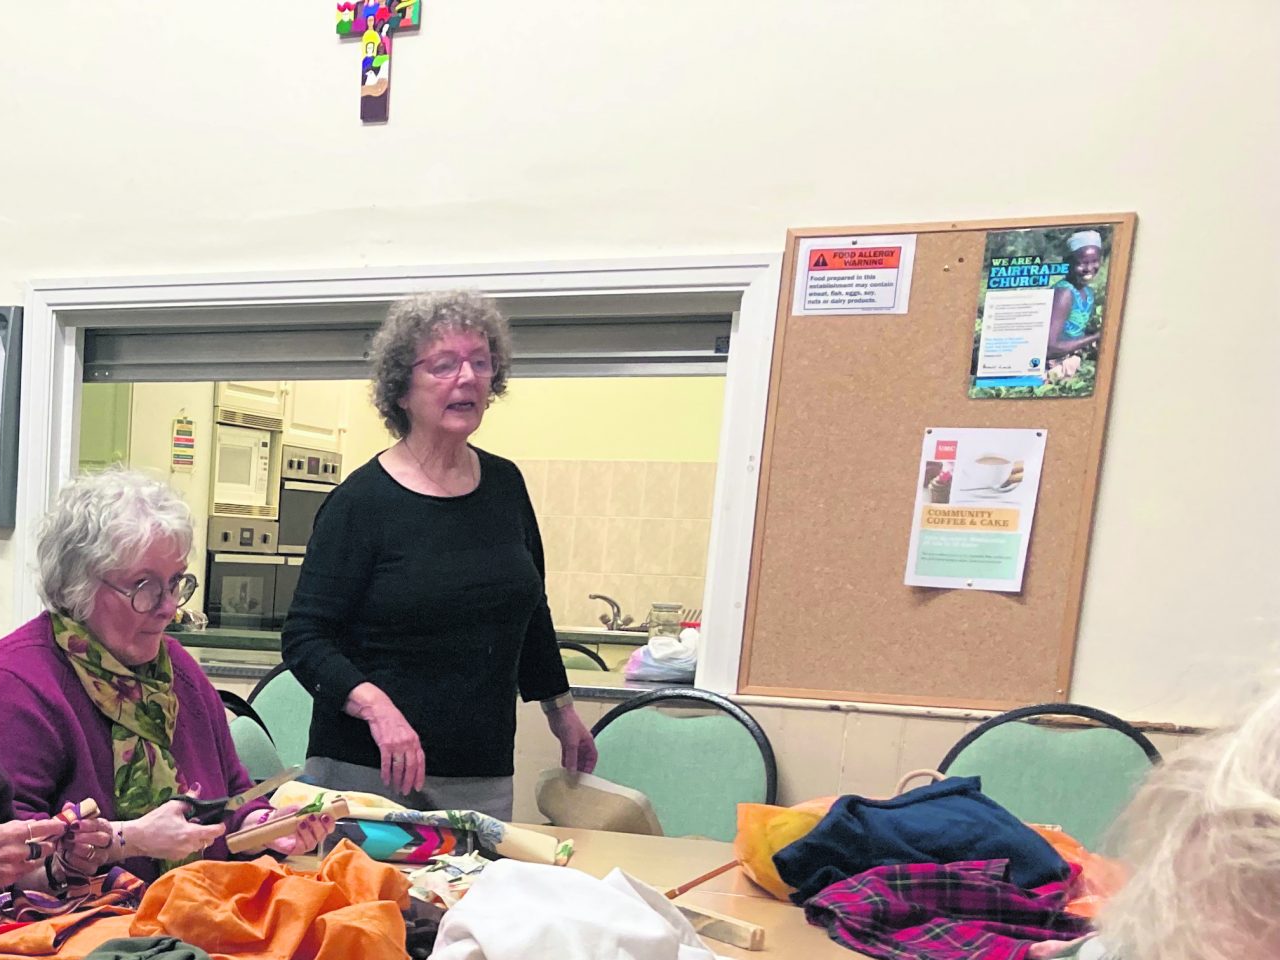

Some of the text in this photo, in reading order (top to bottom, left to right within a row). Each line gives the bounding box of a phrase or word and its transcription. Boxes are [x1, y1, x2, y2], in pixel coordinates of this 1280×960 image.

[833, 250, 896, 259] FOOD ALLERGY
[843, 258, 884, 267] WARNING
[992, 256, 1042, 266] WE ARE A
[990, 263, 1070, 277] FAIRTRADE
[989, 275, 1048, 288] CHURCH
[928, 509, 994, 518] COMMUNITY
[927, 517, 1010, 527] COFFEE & CAKE
